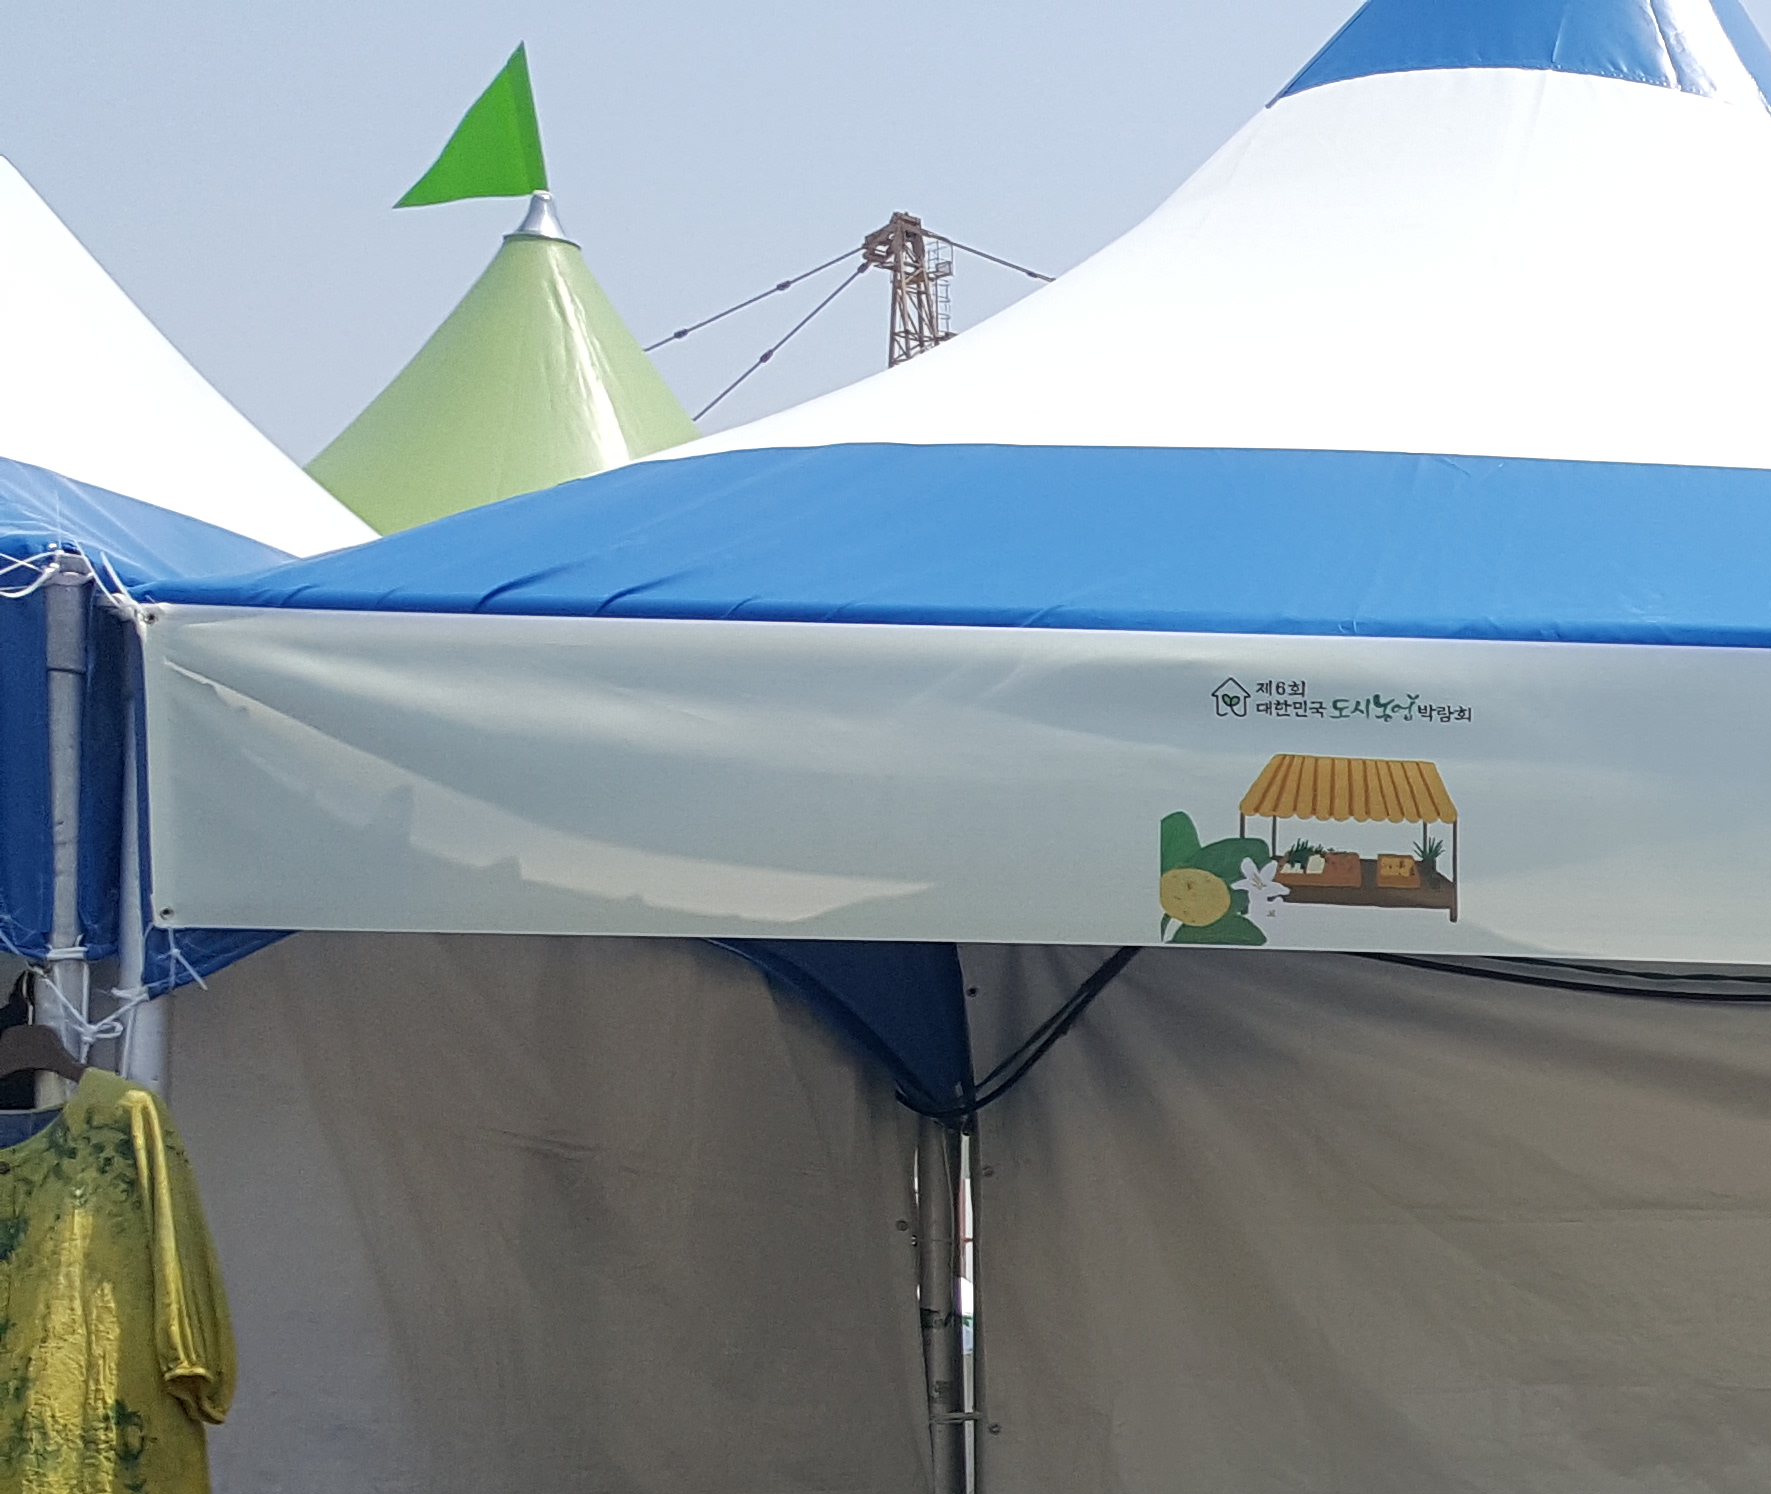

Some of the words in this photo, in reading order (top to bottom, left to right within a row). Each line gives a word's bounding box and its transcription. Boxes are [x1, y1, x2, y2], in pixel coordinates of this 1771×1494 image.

[1255, 679, 1306, 698] 제6회
[1255, 699, 1327, 719] 대한민국
[1418, 704, 1472, 723] 박람회
